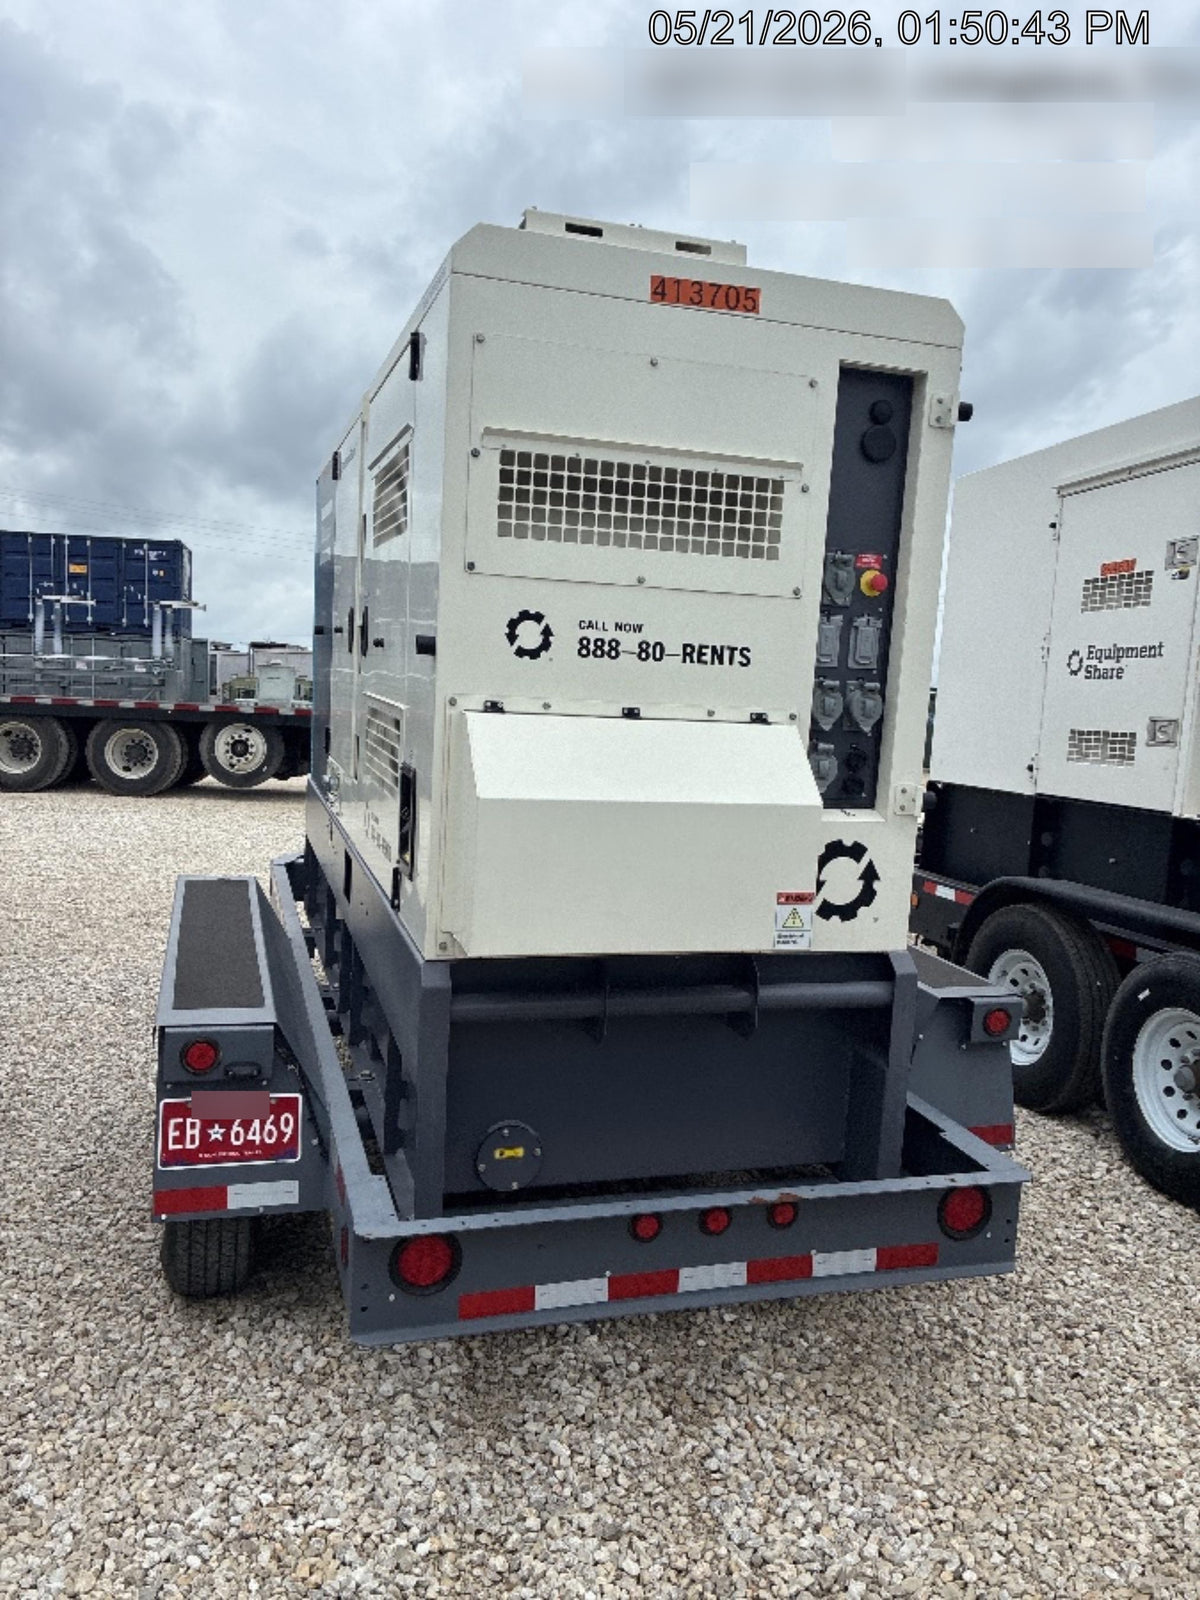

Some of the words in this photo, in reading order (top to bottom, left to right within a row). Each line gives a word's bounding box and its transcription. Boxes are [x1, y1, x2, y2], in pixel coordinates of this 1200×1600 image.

[652, 278, 757, 312] 413705
[578, 620, 608, 632] CALL
[615, 622, 644, 634] NOW
[1086, 641, 1165, 664] Equipment
[1084, 664, 1125, 680] Share
[230, 1112, 294, 1146] 6469
